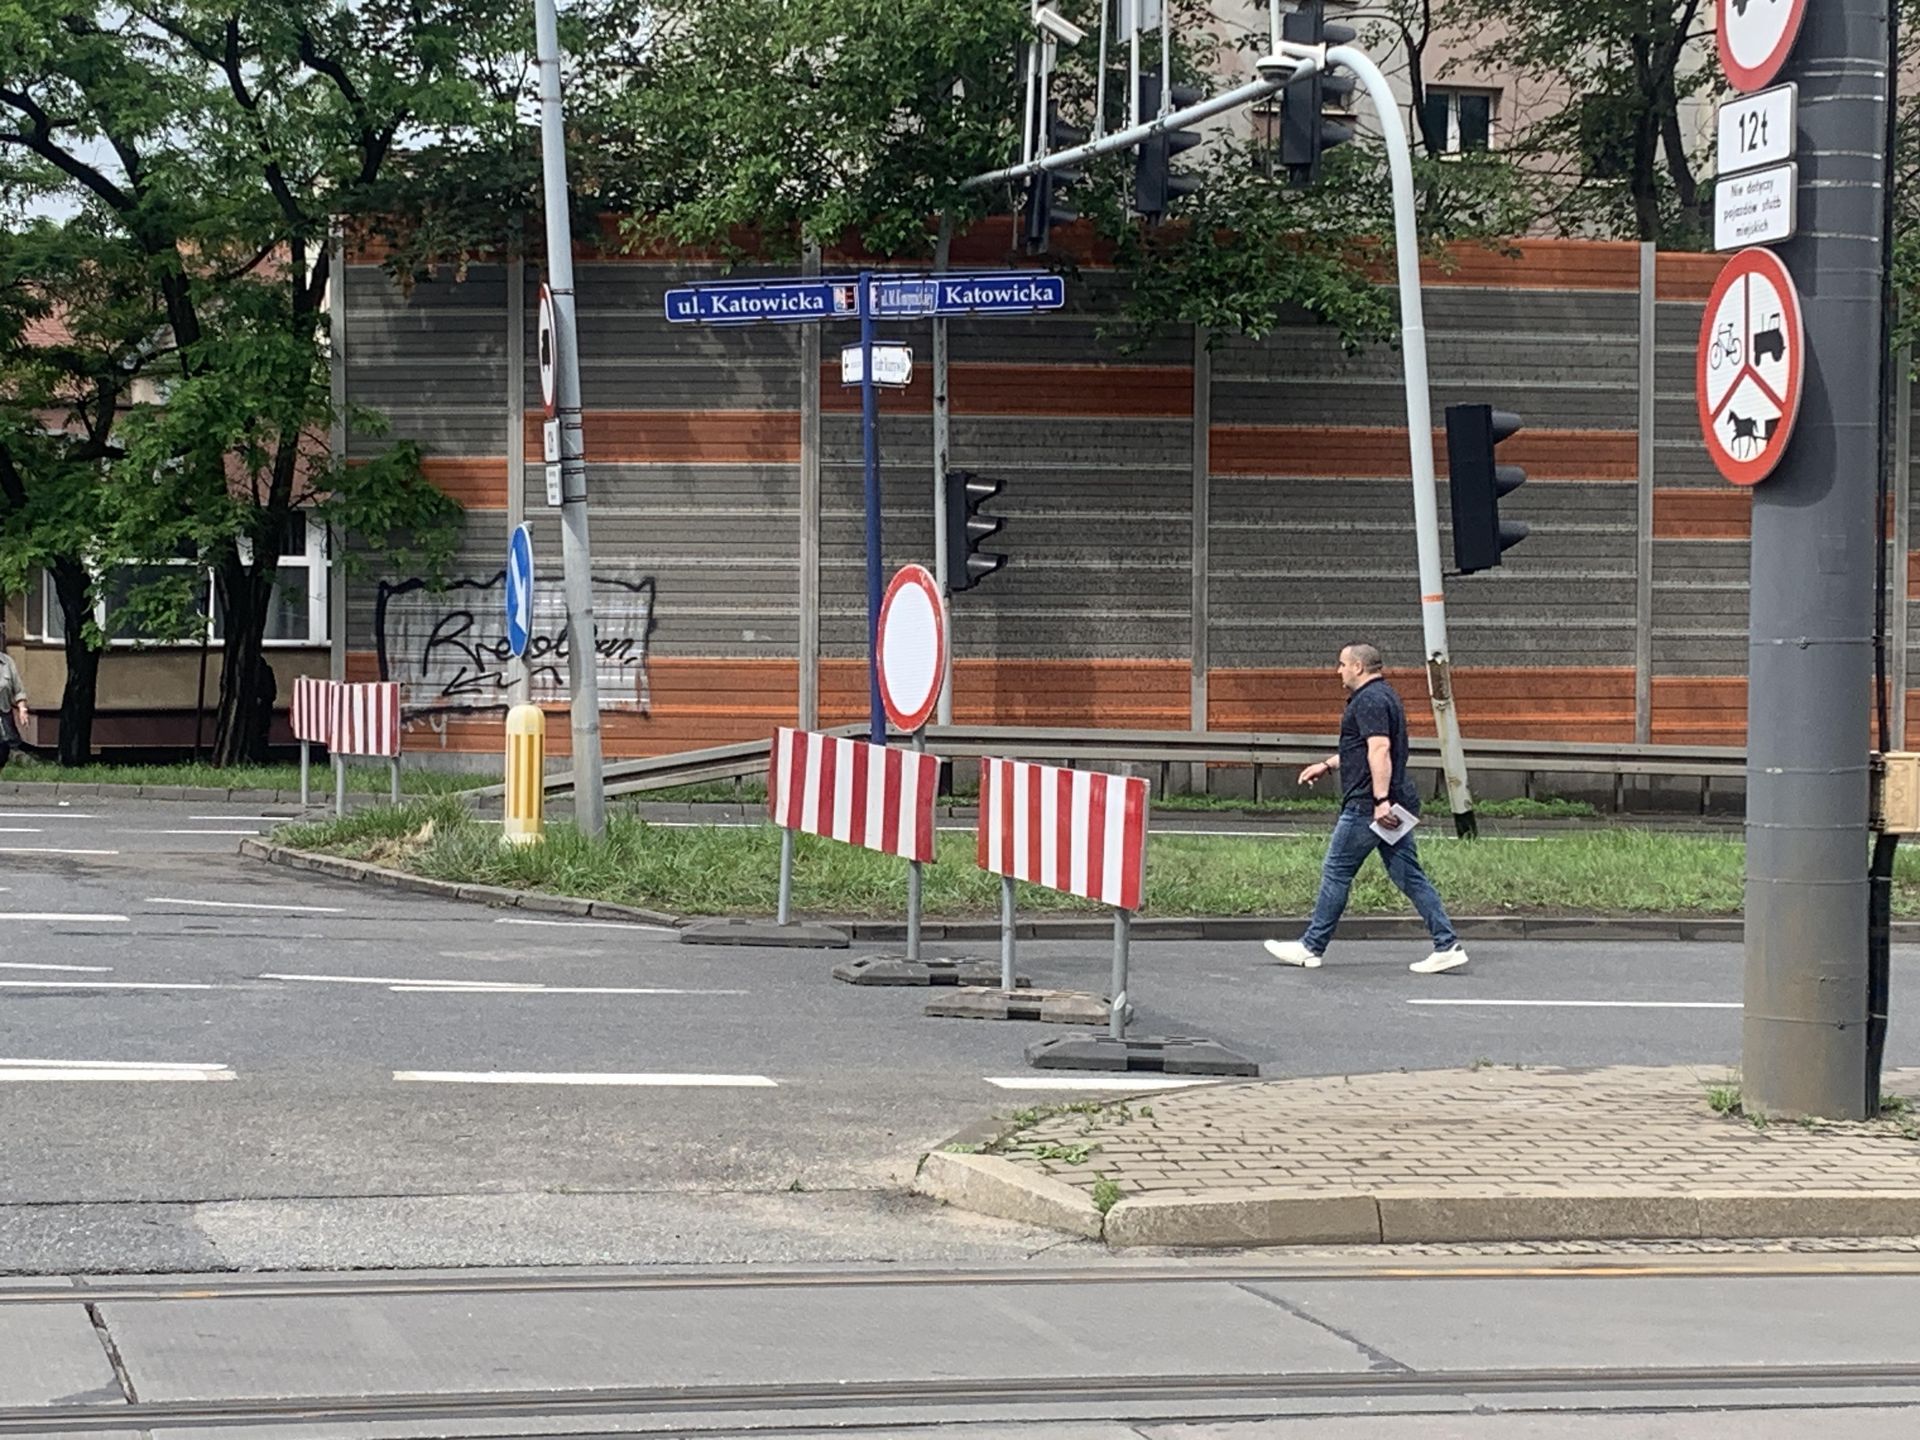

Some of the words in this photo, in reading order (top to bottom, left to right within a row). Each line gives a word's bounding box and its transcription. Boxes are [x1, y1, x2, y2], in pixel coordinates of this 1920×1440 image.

[1738, 108, 1768, 153] 12t
[1731, 182, 1743, 197] Nie
[1746, 179, 1774, 196] dotyczy
[1723, 200, 1757, 223] pojazdów
[1735, 218, 1769, 239] miejskich
[677, 296, 705, 315] ul.
[711, 292, 824, 314] Katowicka
[945, 283, 1054, 304] Katowicka
